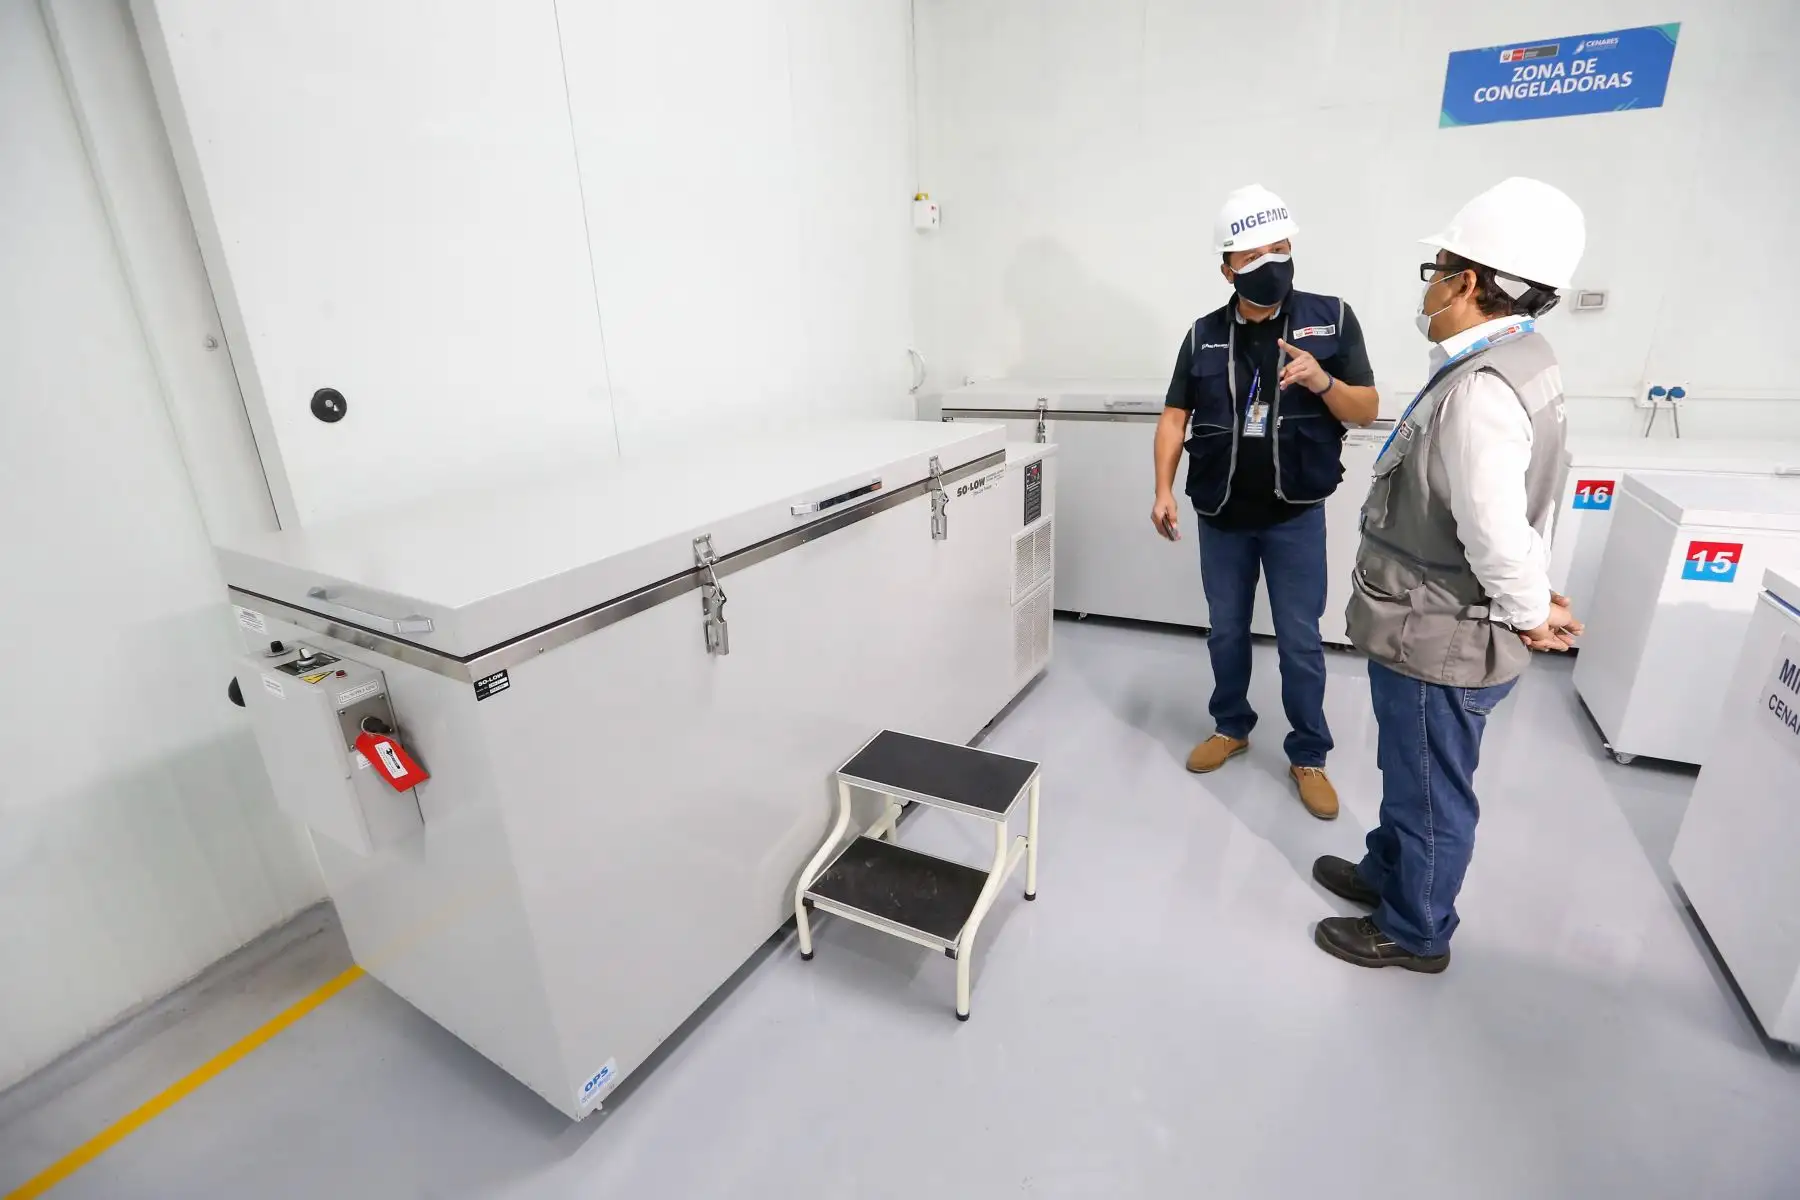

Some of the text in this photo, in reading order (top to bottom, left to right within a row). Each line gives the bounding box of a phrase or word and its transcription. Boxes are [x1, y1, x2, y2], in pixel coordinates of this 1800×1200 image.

[1511, 57, 1598, 82] ZONA DE
[1474, 71, 1632, 103] CONGELADORAS
[1230, 207, 1289, 236] DIGEMID
[1579, 486, 1609, 504] 16
[1691, 550, 1734, 574] 15
[584, 1066, 609, 1092] OPS
